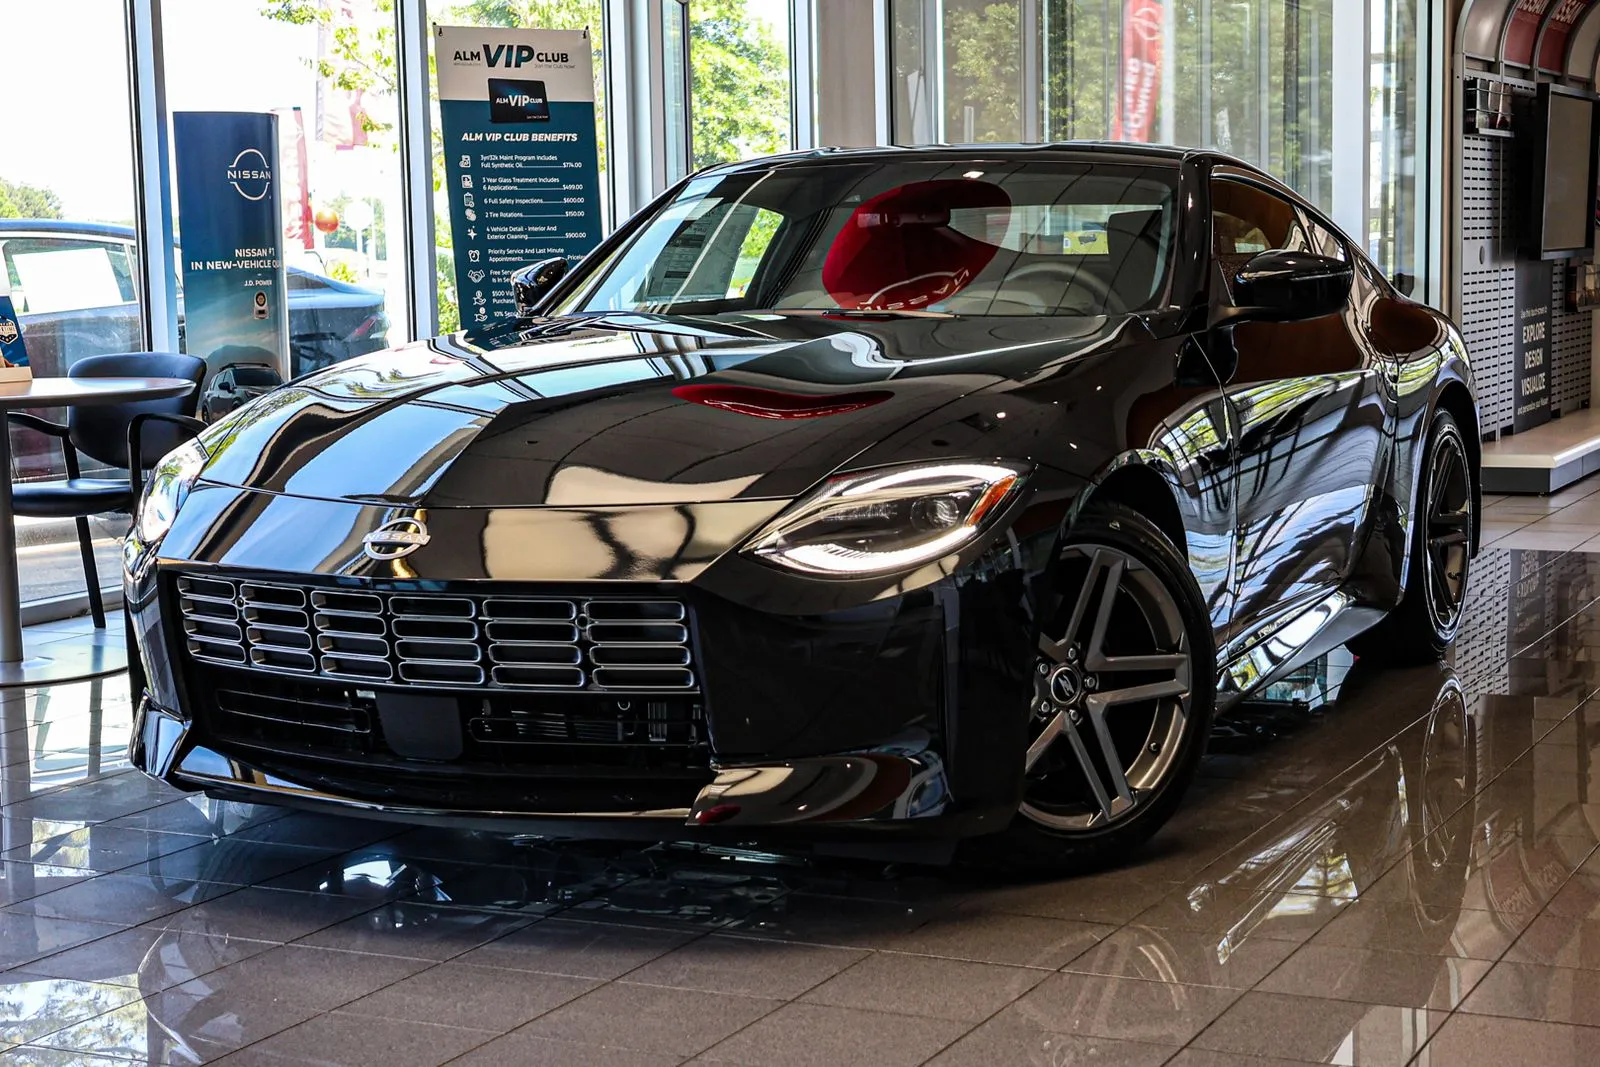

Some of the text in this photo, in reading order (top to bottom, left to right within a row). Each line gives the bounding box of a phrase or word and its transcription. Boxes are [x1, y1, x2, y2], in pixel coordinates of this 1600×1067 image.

[454, 51, 480, 61] ALM
[482, 44, 534, 68] VIP
[537, 53, 568, 62] CLUB
[508, 95, 529, 106] VIP
[462, 133, 483, 141] ALM
[484, 133, 502, 141] VIP
[227, 170, 271, 180] NISSAN
[235, 248, 267, 257] NISSAN
[191, 261, 202, 270] IN
[206, 260, 272, 270] NEW-VEHICLE
[1522, 321, 1546, 344] EXPLORE
[1524, 348, 1543, 369] DESIGN
[1521, 372, 1546, 396] VISUALIZE
